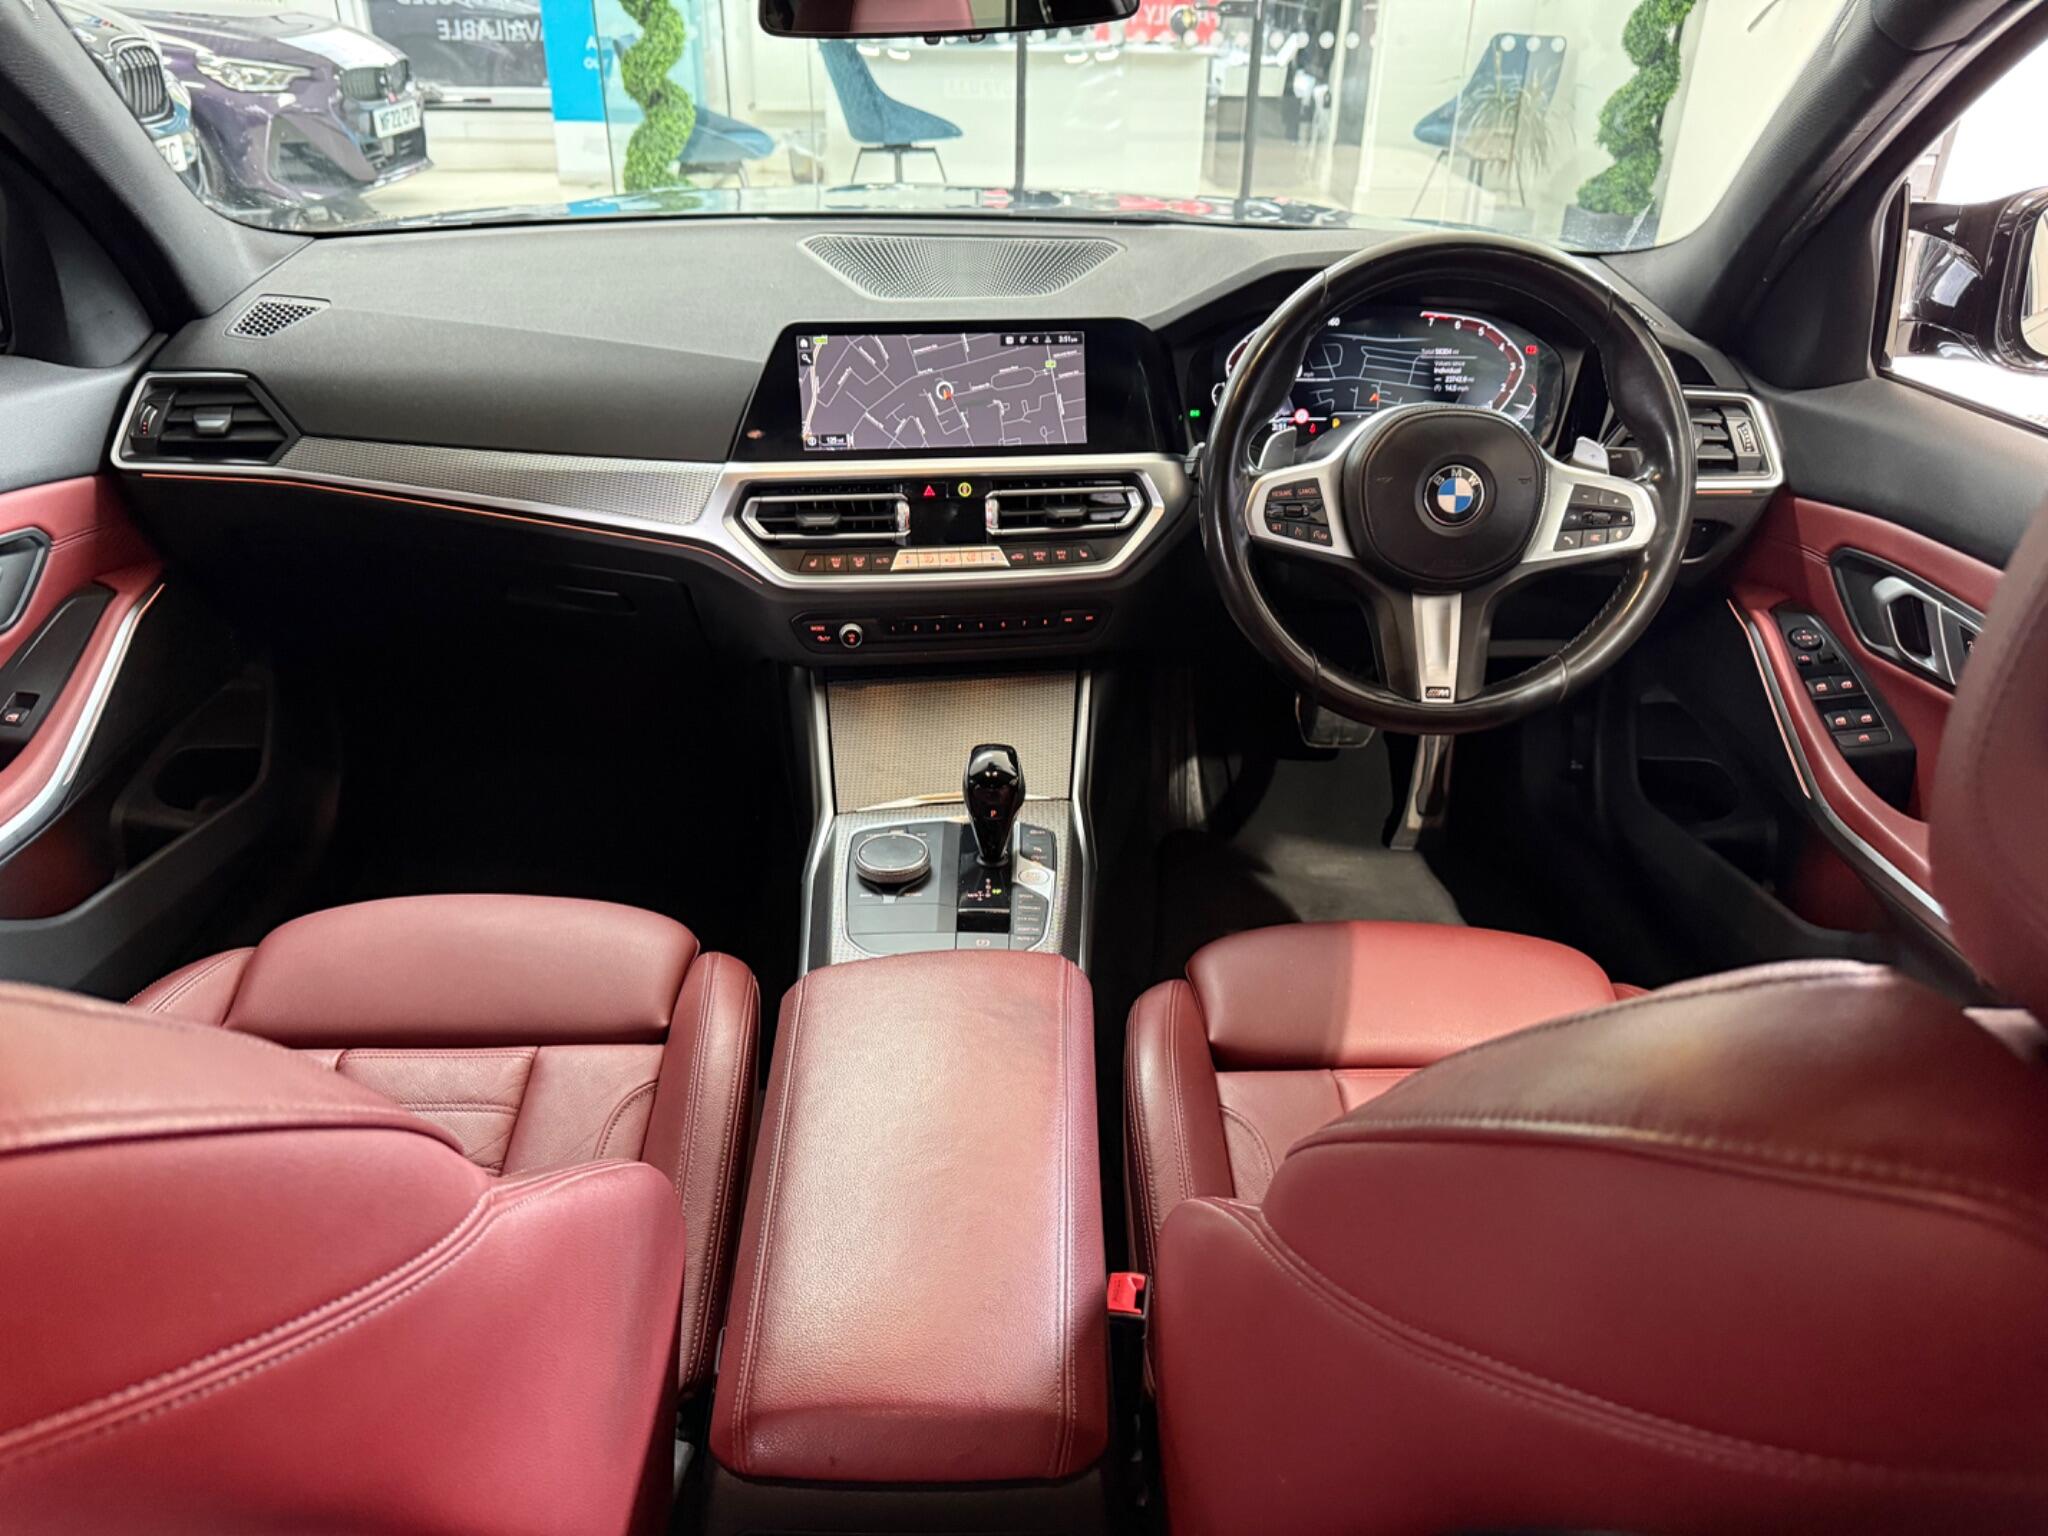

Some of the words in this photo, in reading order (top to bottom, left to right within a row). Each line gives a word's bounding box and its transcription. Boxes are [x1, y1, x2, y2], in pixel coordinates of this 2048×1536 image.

[1429, 317, 1435, 327] 7
[1455, 320, 1461, 330] 6
[1478, 327, 1486, 336] 5
[1499, 343, 1505, 352] 4
[1510, 362, 1516, 371] 3
[1501, 383, 1506, 392] 2
[1433, 467, 1480, 487] BMW
